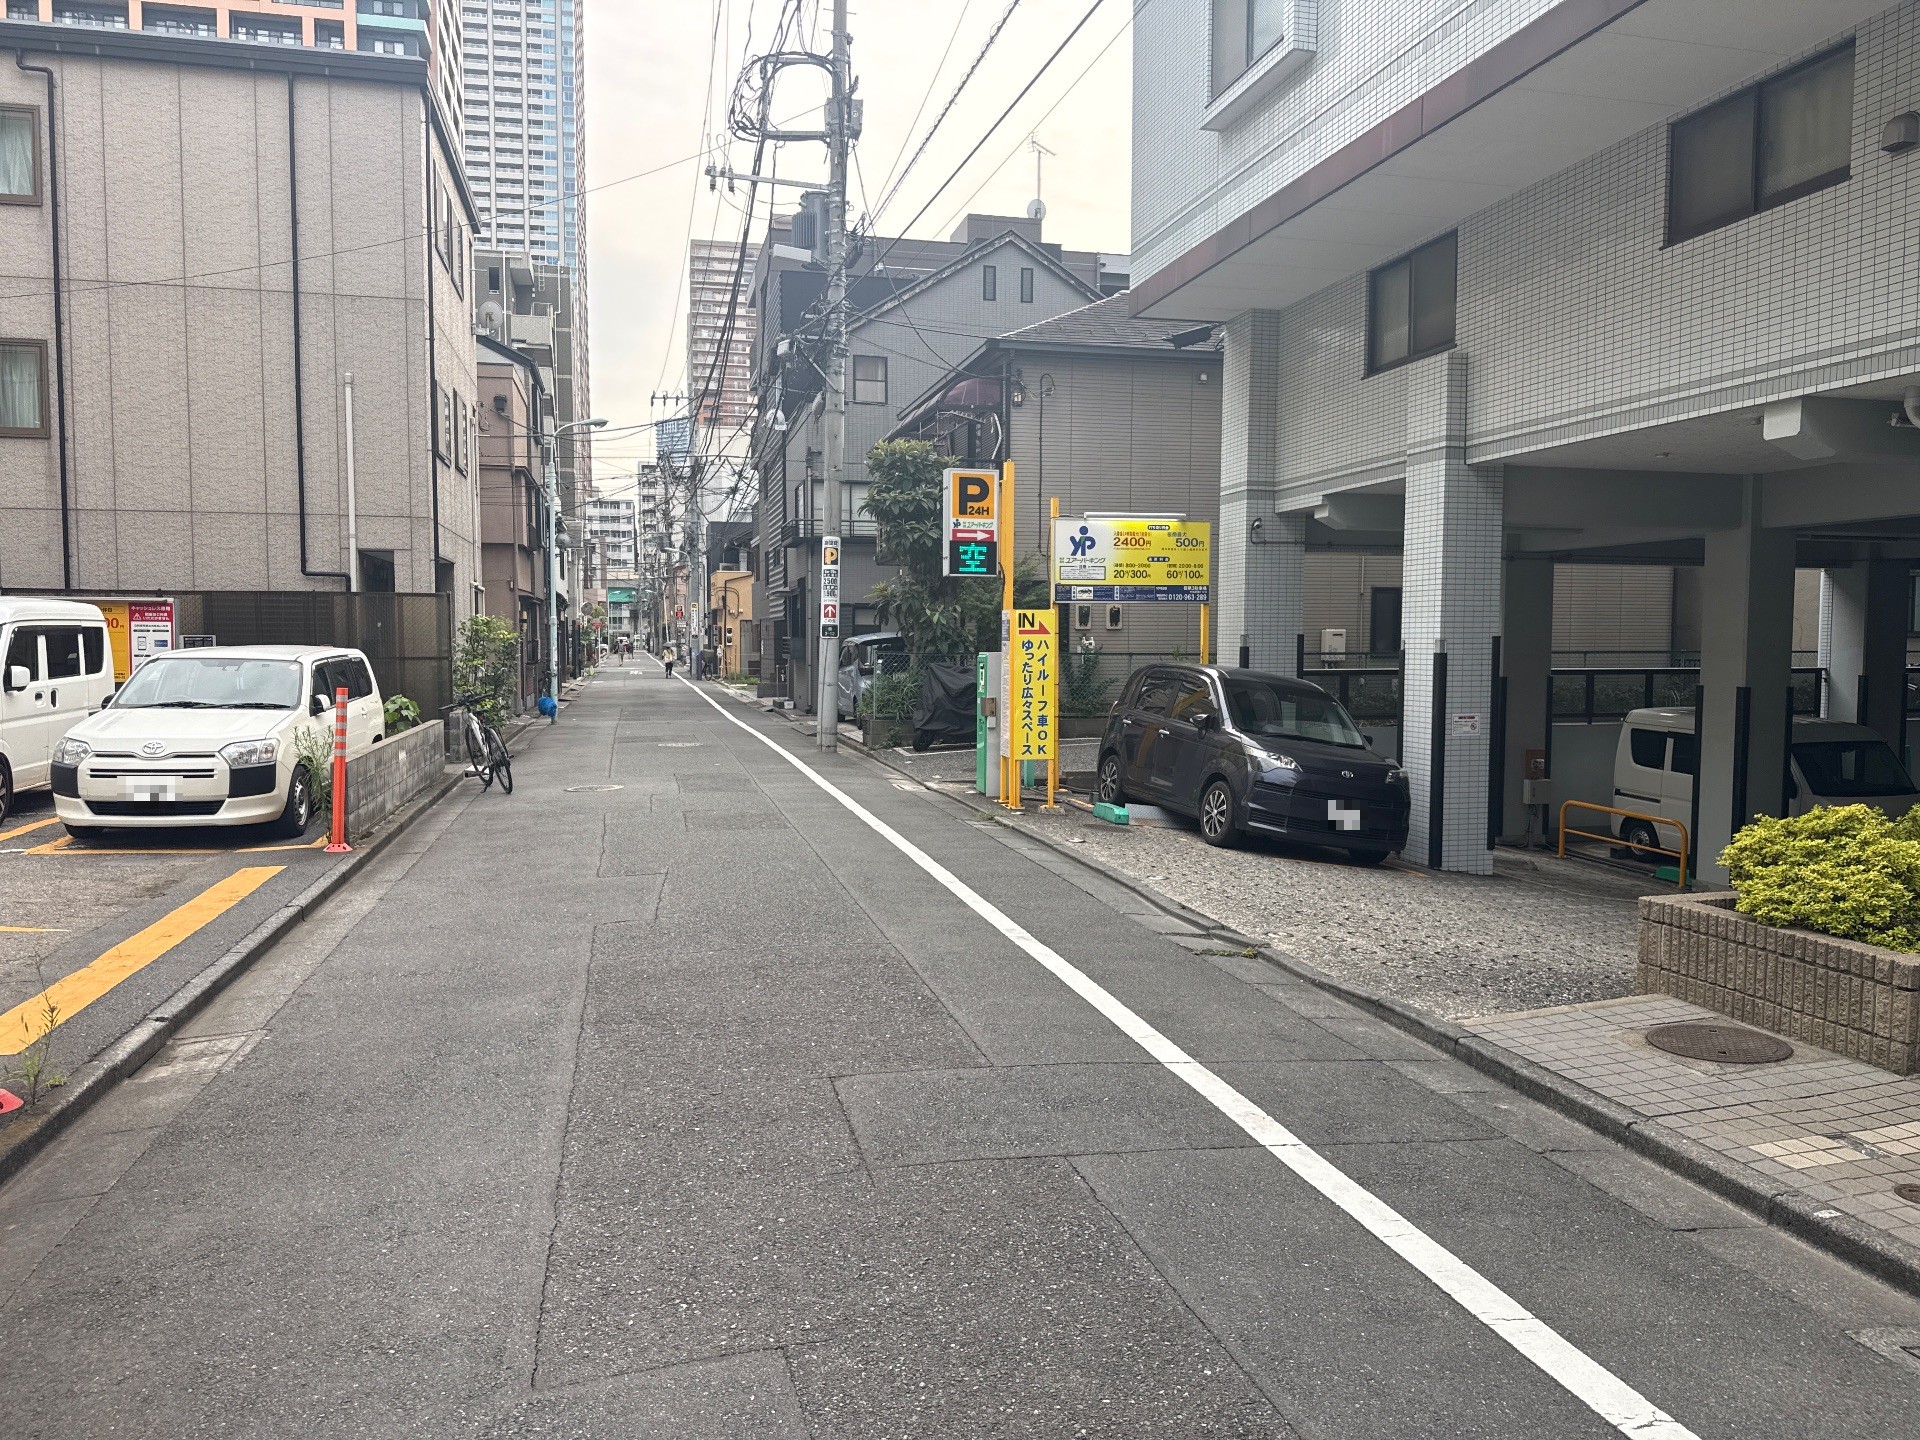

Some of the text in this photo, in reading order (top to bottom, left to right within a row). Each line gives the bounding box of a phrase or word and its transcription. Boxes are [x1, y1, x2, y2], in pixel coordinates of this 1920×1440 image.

[959, 477, 990, 515] P
[968, 506, 989, 516] 24H
[1113, 537, 1152, 547] 2400円
[1175, 538, 1205, 547] 500円
[959, 542, 988, 572] 空
[1018, 612, 1035, 628] IN
[1021, 639, 1035, 756] ゆったり広々スペース
[1036, 640, 1050, 755] ハイルーフ車OK
